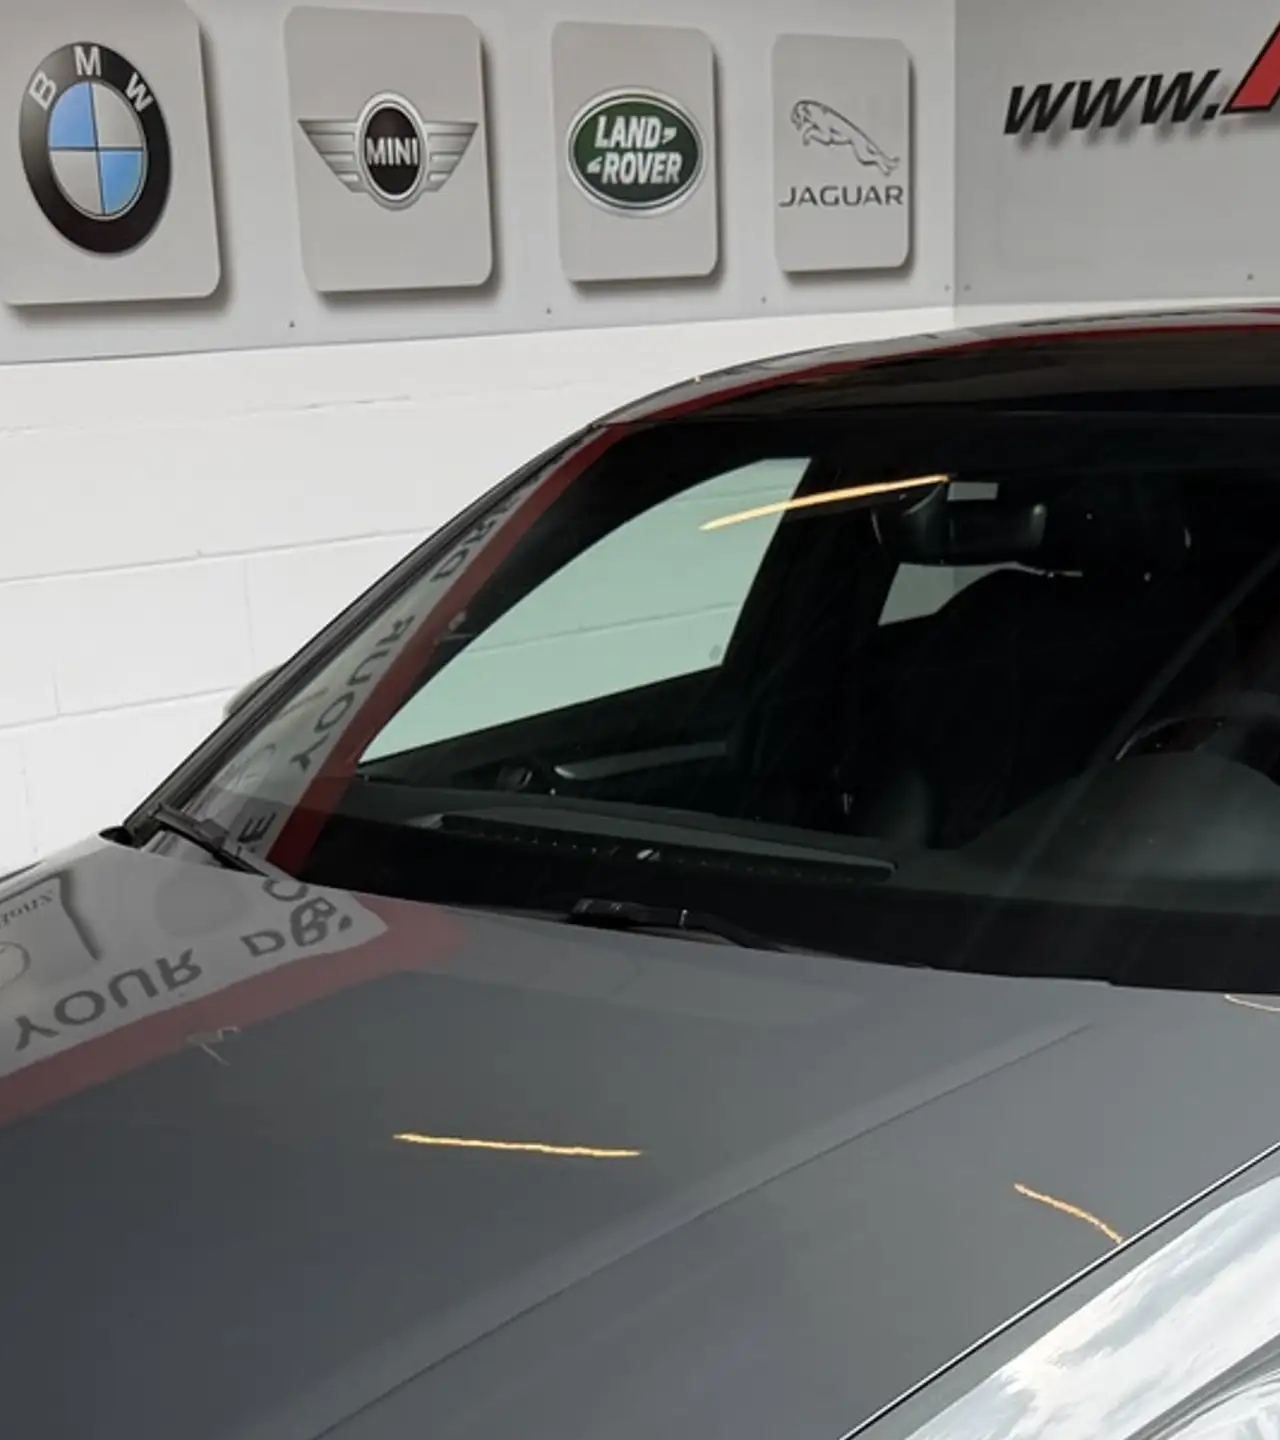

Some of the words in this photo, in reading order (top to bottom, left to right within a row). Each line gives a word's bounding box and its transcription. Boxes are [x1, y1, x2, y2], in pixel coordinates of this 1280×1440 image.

[27, 45, 154, 112] BMW
[594, 114, 660, 150] LAND
[365, 136, 420, 167] MINI
[601, 151, 684, 189] ROVER
[777, 183, 904, 209] JAGUAR
